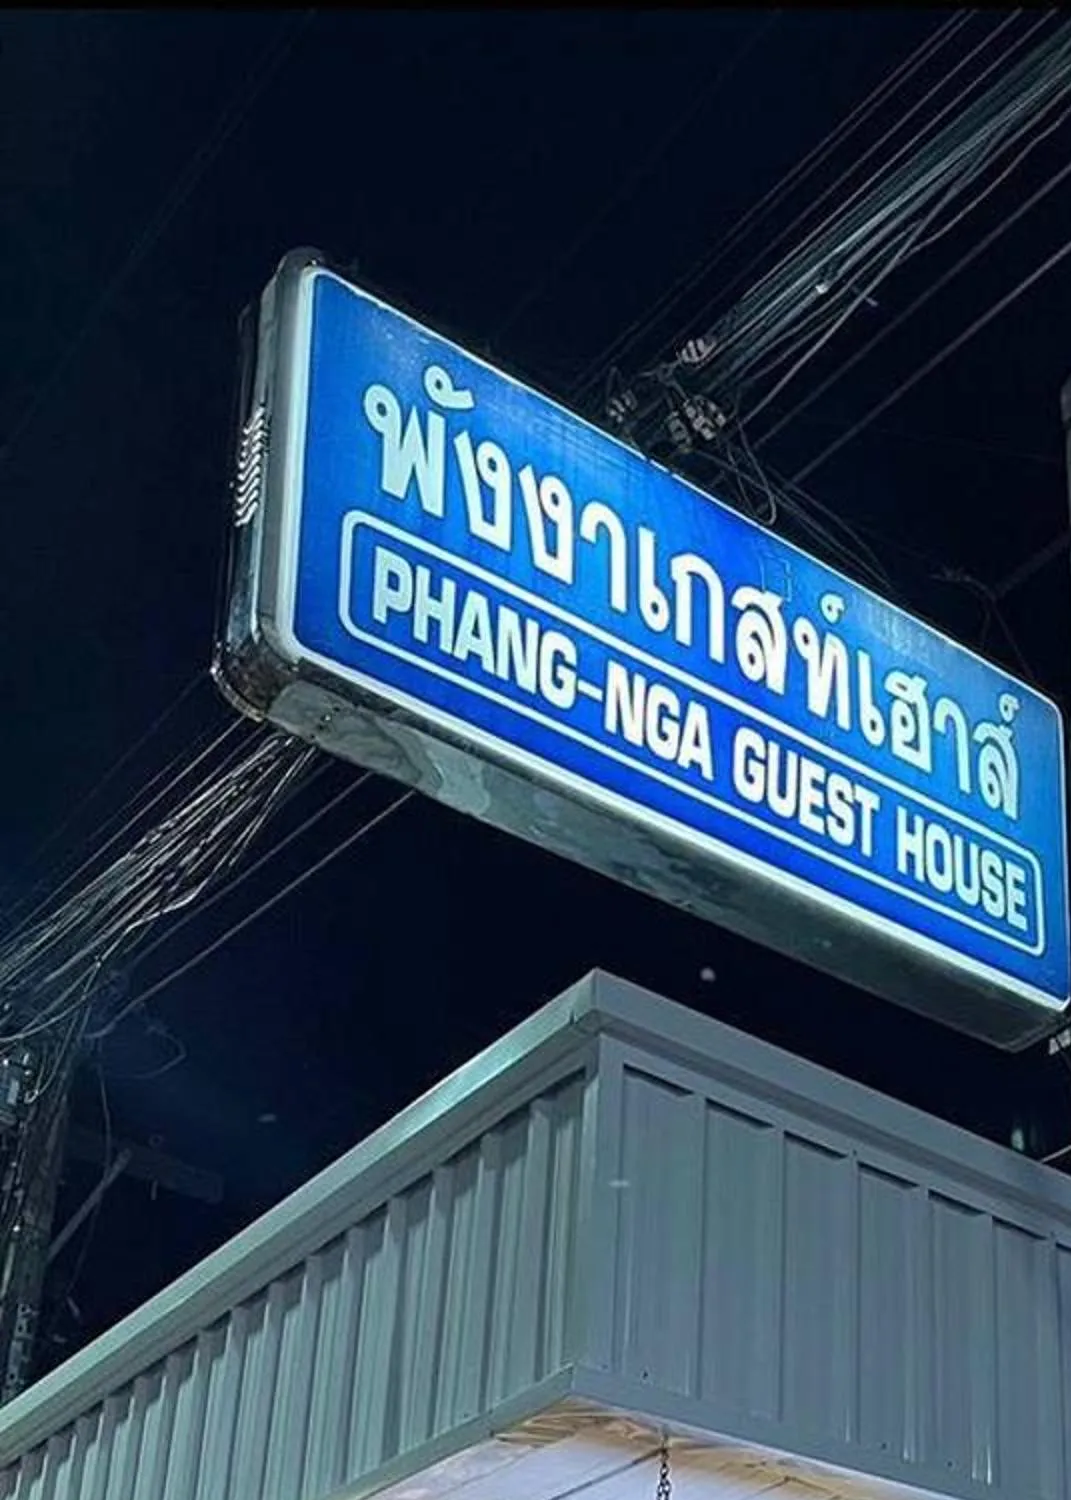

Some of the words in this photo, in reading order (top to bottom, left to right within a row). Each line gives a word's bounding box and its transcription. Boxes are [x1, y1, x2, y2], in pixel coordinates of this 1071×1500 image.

[363, 364, 1020, 821] พังงาเกสท์เฮาส์
[372, 545, 714, 781] PHANG-NGA
[733, 726, 880, 857] GUEST
[897, 805, 1028, 931] HOUSE
